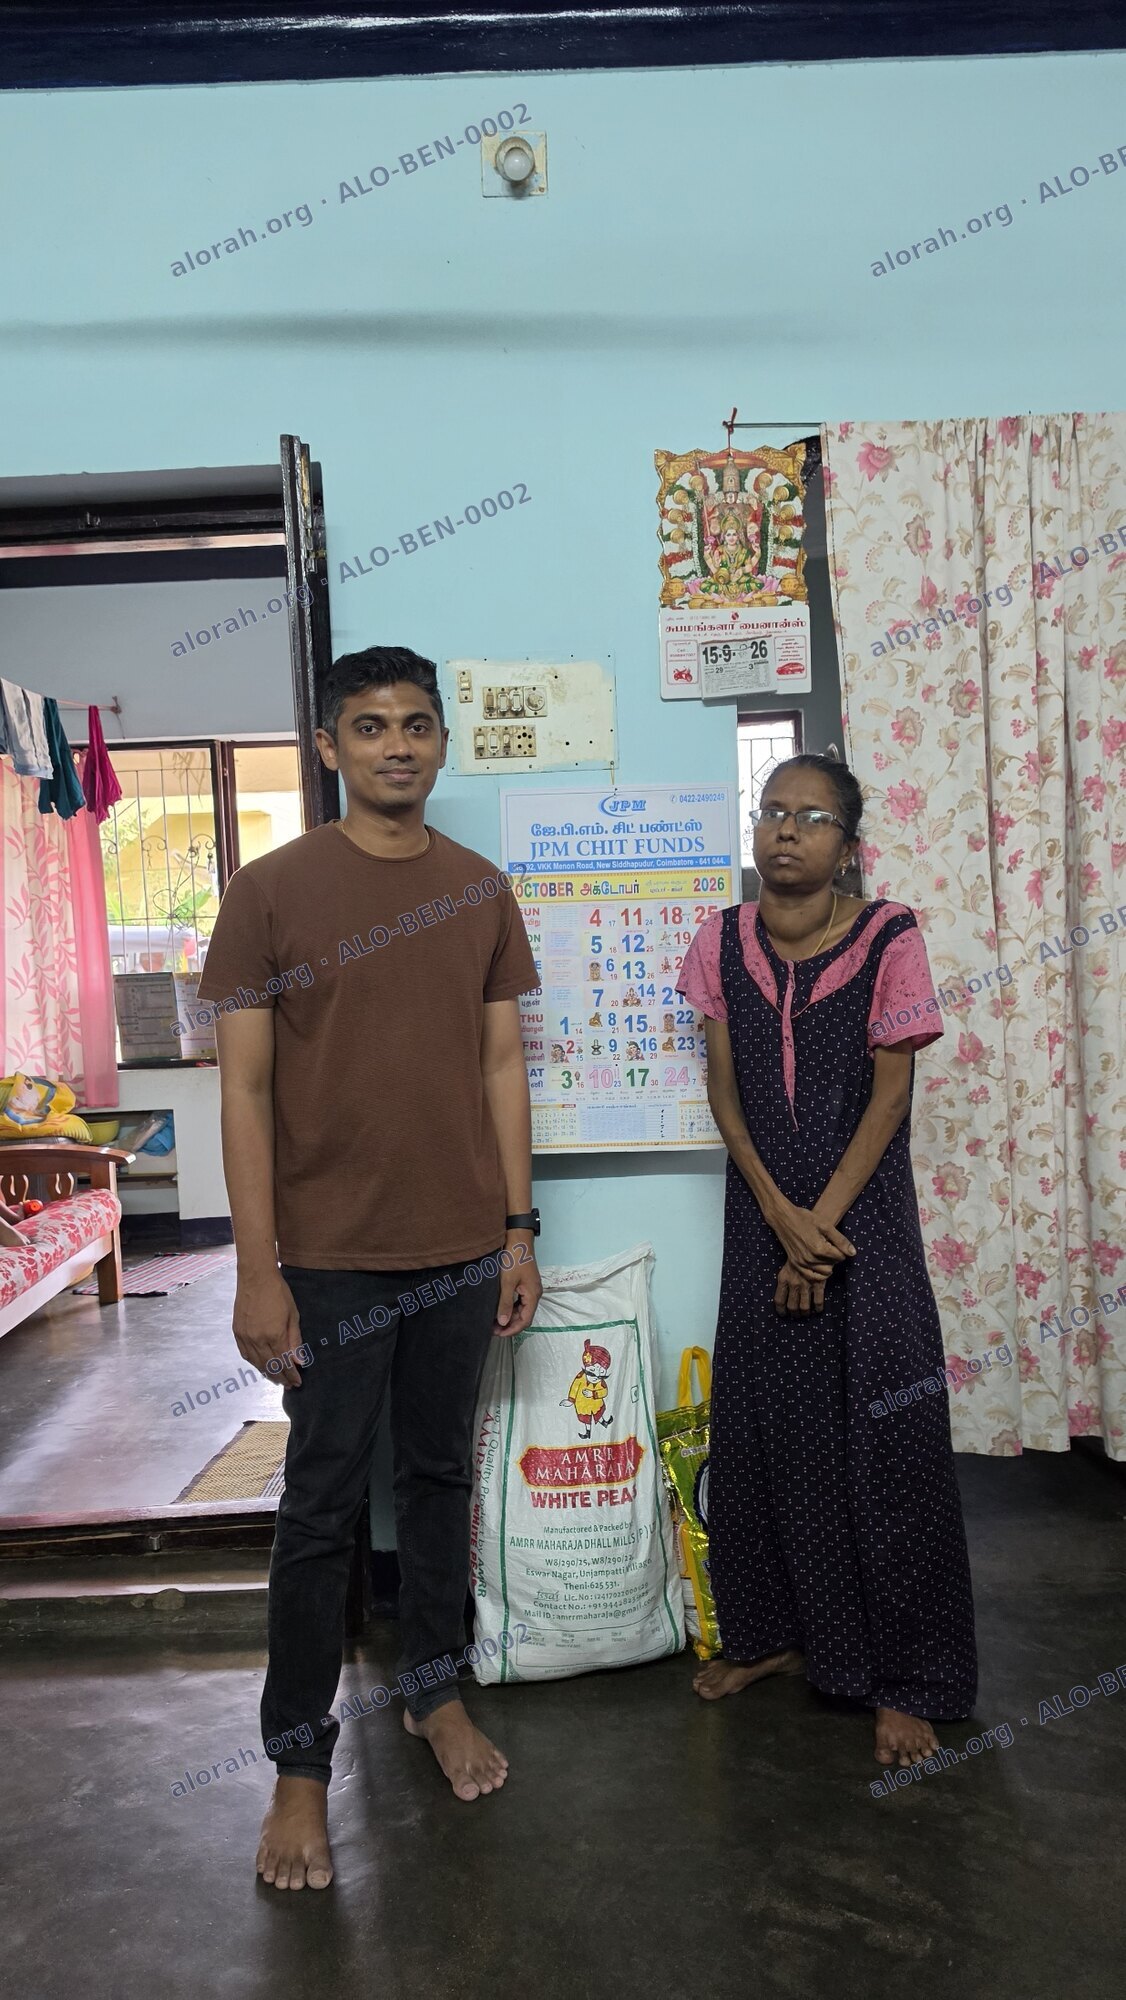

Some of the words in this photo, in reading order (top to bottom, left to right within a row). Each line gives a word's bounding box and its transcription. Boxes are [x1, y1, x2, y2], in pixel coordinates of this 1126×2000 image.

[751, 640, 768, 659] 26
[609, 798, 647, 812] JPM
[612, 821, 635, 836] சிட்
[530, 841, 569, 861] JPM
[576, 839, 634, 857] CHIT
[635, 836, 705, 855] FUNDS
[553, 862, 575, 870] Menon
[576, 861, 595, 870] Road,
[597, 860, 610, 869] New
[612, 859, 654, 870] Siddhapudur,
[656, 858, 694, 867] Coimbatore
[515, 881, 574, 898] OCTOBER
[580, 879, 640, 896] அக்டோபர்
[693, 877, 725, 892] 2026
[589, 908, 602, 927] 4
[620, 907, 642, 927] 11
[659, 906, 683, 925] 18
[591, 935, 603, 954] 5
[621, 934, 646, 953] 12
[674, 931, 692, 945] 19
[606, 958, 615, 972] 6
[622, 961, 646, 980] 13
[592, 989, 604, 1007] 7
[637, 983, 656, 998] 14
[520, 1014, 544, 1023] THU
[560, 1016, 569, 1035] 1
[608, 1012, 617, 1026] 8
[624, 1014, 648, 1033] 15
[676, 1010, 695, 1025] 22
[523, 1041, 543, 1050] FRI
[566, 1040, 575, 1054] 2
[609, 1038, 618, 1053] 9
[640, 1037, 657, 1052] 16
[677, 1036, 696, 1051] 23
[613, 1053, 621, 1061] 22
[650, 1052, 658, 1060] 29
[561, 1070, 573, 1089] 3
[589, 1068, 614, 1089] 10
[626, 1068, 650, 1087] 17
[664, 1065, 691, 1087] 24
[614, 1080, 622, 1088] 23
[482, 1439, 499, 1484] Quality
[561, 1447, 615, 1465] AMRR
[536, 1459, 635, 1481] MAHARAJA
[530, 1490, 592, 1509] WHITE
[479, 1486, 489, 1535] Product
[543, 1525, 592, 1534] Manufactured
[600, 1522, 624, 1532] Packed
[476, 1539, 485, 1555] by
[510, 1536, 535, 1549] AMRR
[536, 1539, 583, 1551] MAHARAJA
[584, 1537, 612, 1549] DHALL
[612, 1533, 636, 1548] MILLS
[526, 1568, 550, 1577] Eswar
[552, 1571, 579, 1581] Nagar,
[579, 1566, 625, 1579] Unjampatti
[524, 1609, 541, 1617] Mail
[533, 1600, 566, 1610] Contact
